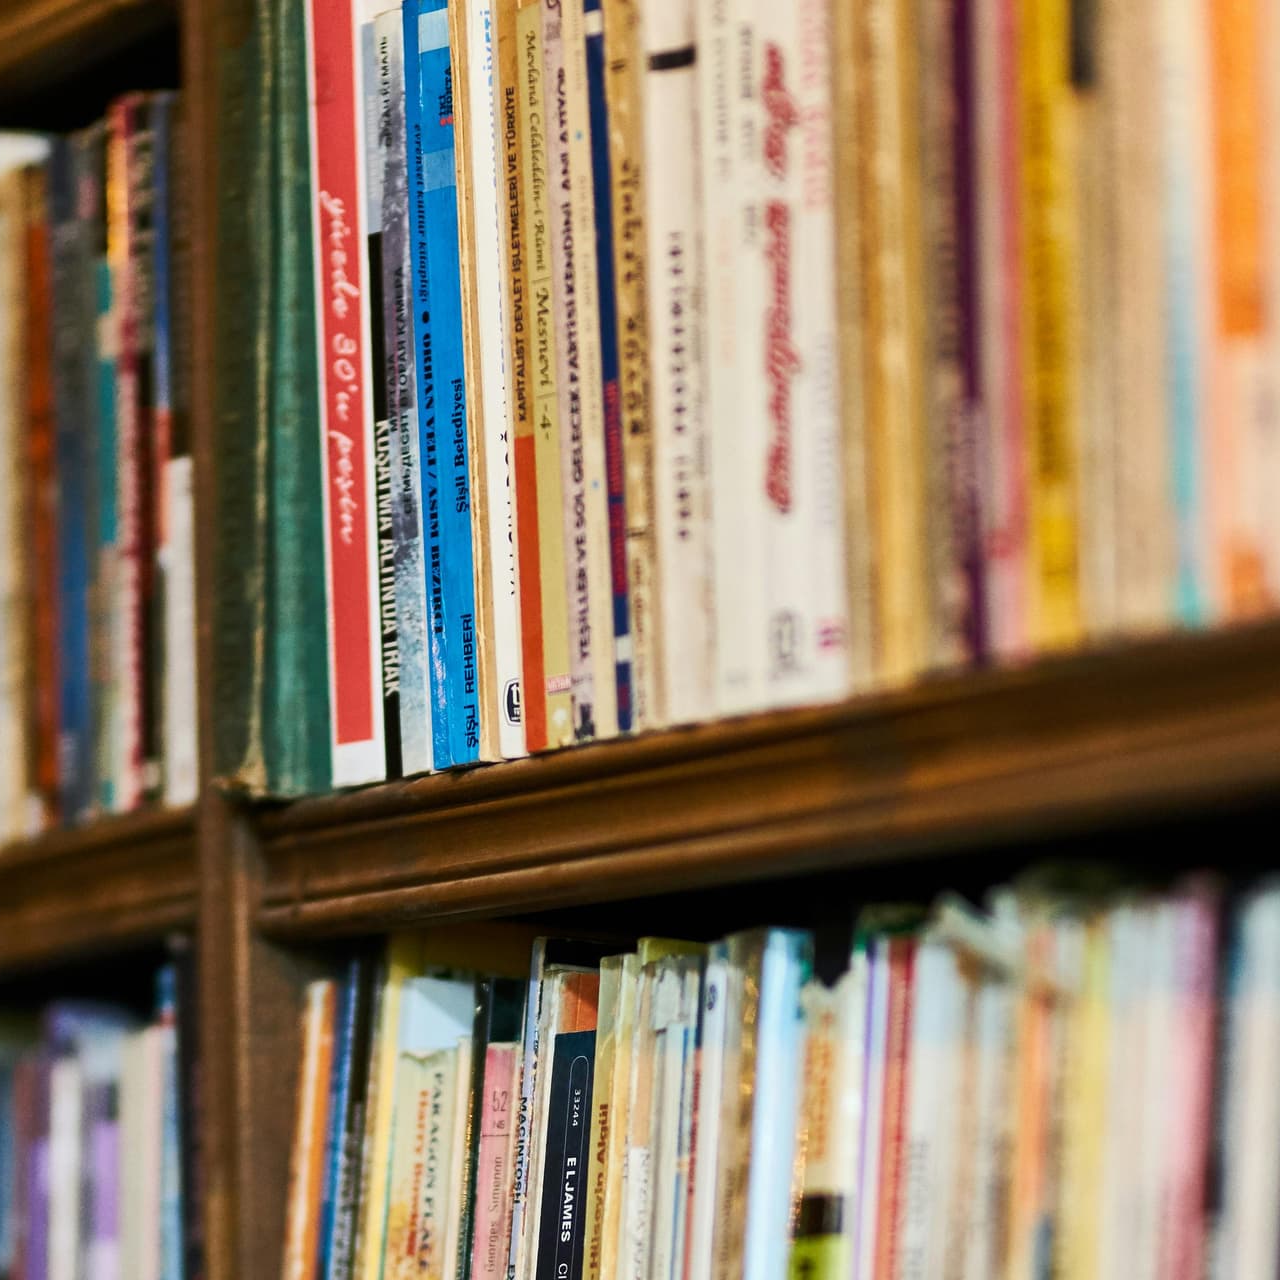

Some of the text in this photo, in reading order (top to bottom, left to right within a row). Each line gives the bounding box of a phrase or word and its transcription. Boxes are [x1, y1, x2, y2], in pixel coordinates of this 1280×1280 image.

[508, 154, 516, 171] VE
[513, 277, 523, 332] DEVLET
[423, 333, 434, 410] ORHAN
[452, 378, 469, 513] Şişli Belediyesi
[569, 389, 582, 483] GELECEK
[574, 491, 586, 528] SOL
[575, 534, 586, 562] VE
[383, 641, 400, 697] IRAK
[462, 613, 479, 748] ŞİŞLİ REHBERİ
[572, 1088, 580, 1127] 33244
[514, 1096, 527, 1204] MACINTOSH
[486, 1156, 502, 1272] Georges Simenon
[562, 1179, 574, 1242] JAMES
